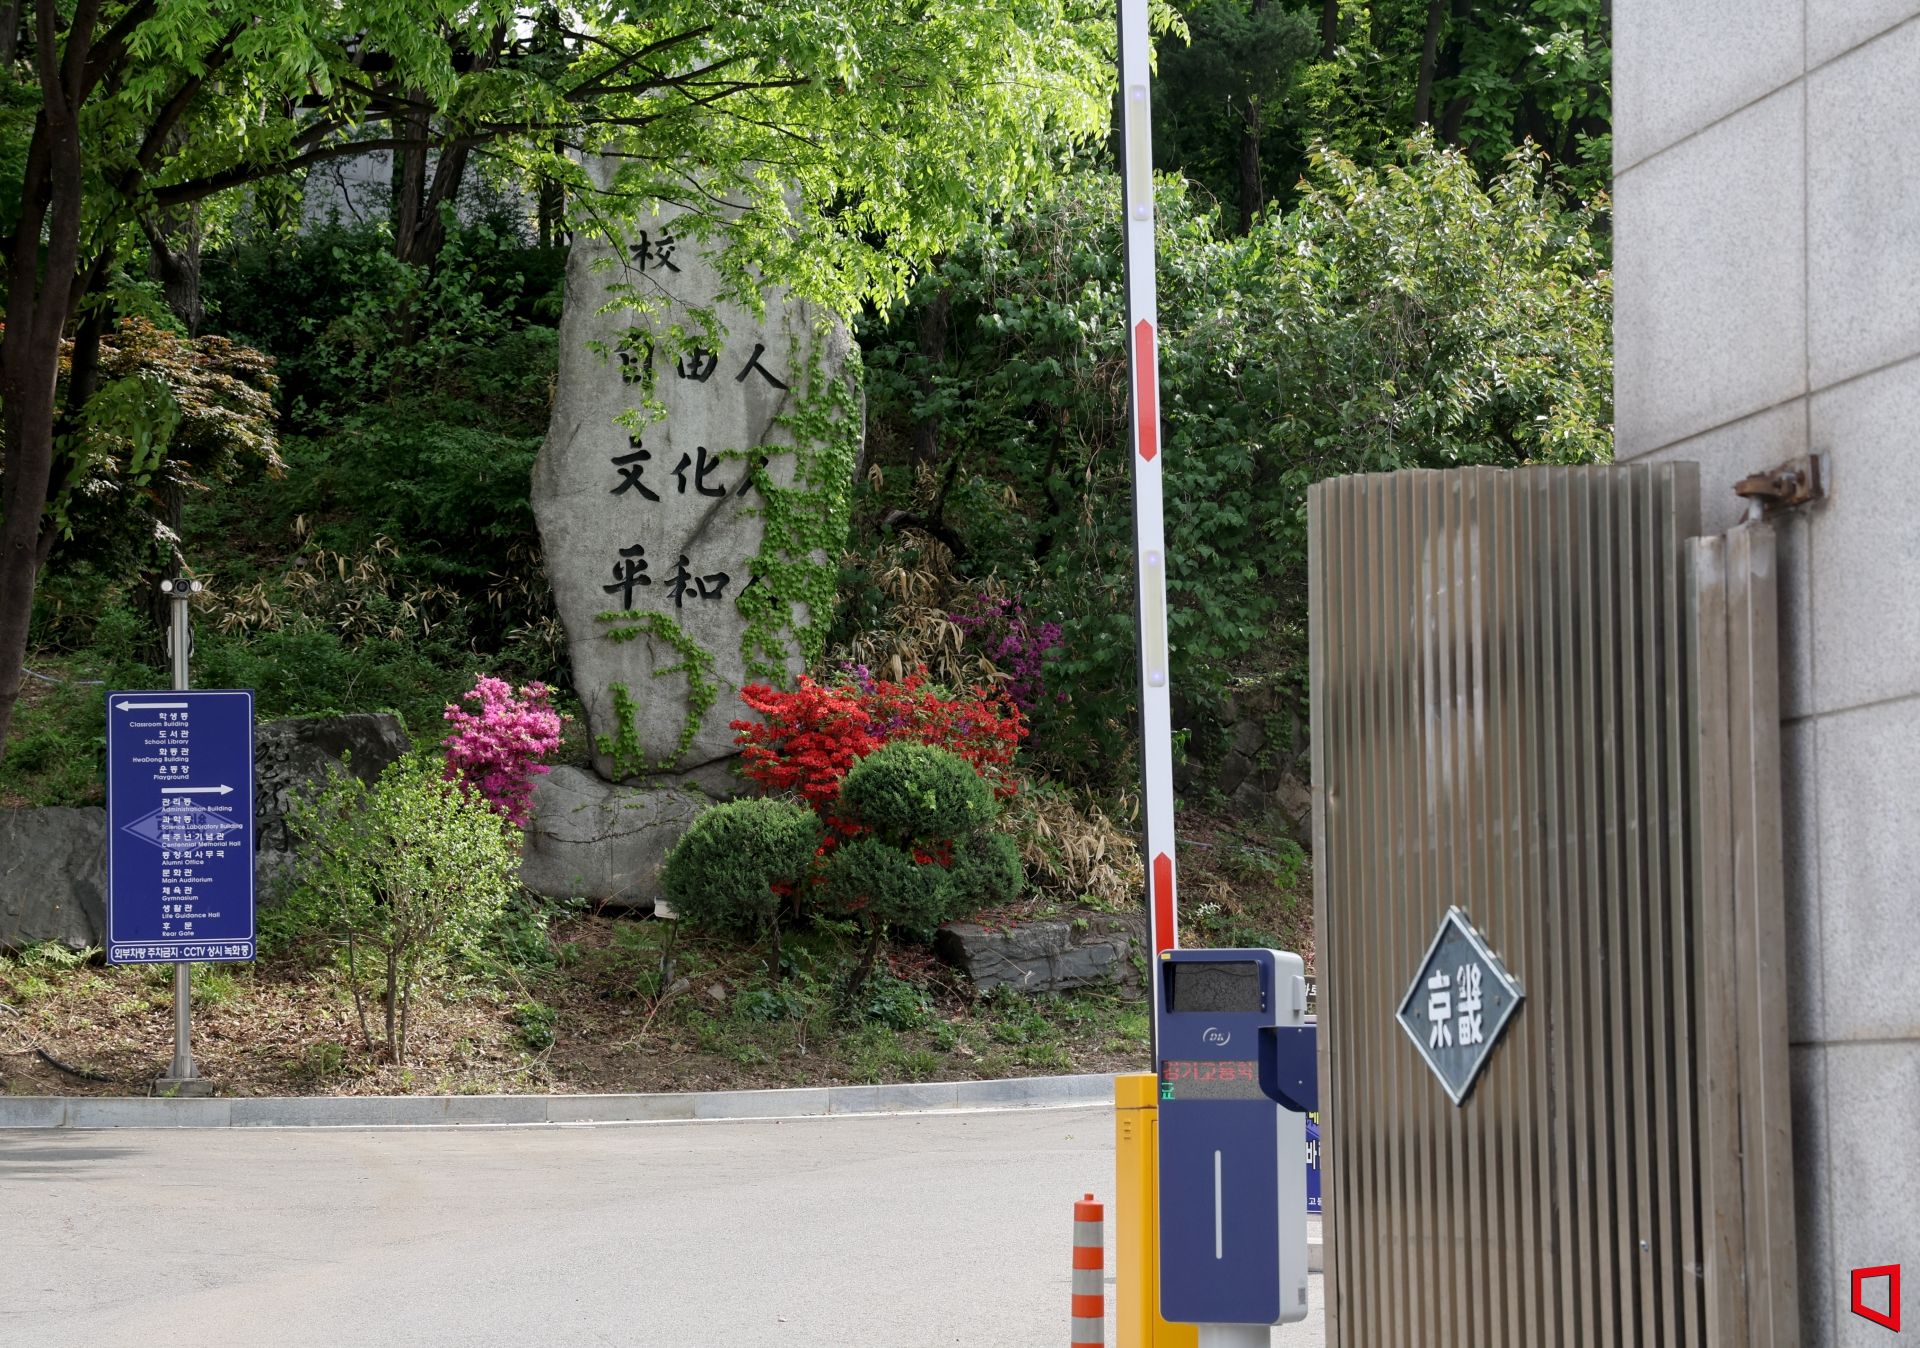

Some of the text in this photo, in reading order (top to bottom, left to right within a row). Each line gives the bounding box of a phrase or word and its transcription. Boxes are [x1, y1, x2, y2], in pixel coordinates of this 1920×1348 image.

[159, 730, 189, 738] 도서관
[115, 949, 146, 958] 외부차량
[148, 947, 178, 958] 주차금지
[207, 946, 222, 957] 상시
[1427, 962, 1484, 1049] 京畿
[1163, 1061, 1255, 1081] 경기고등학
